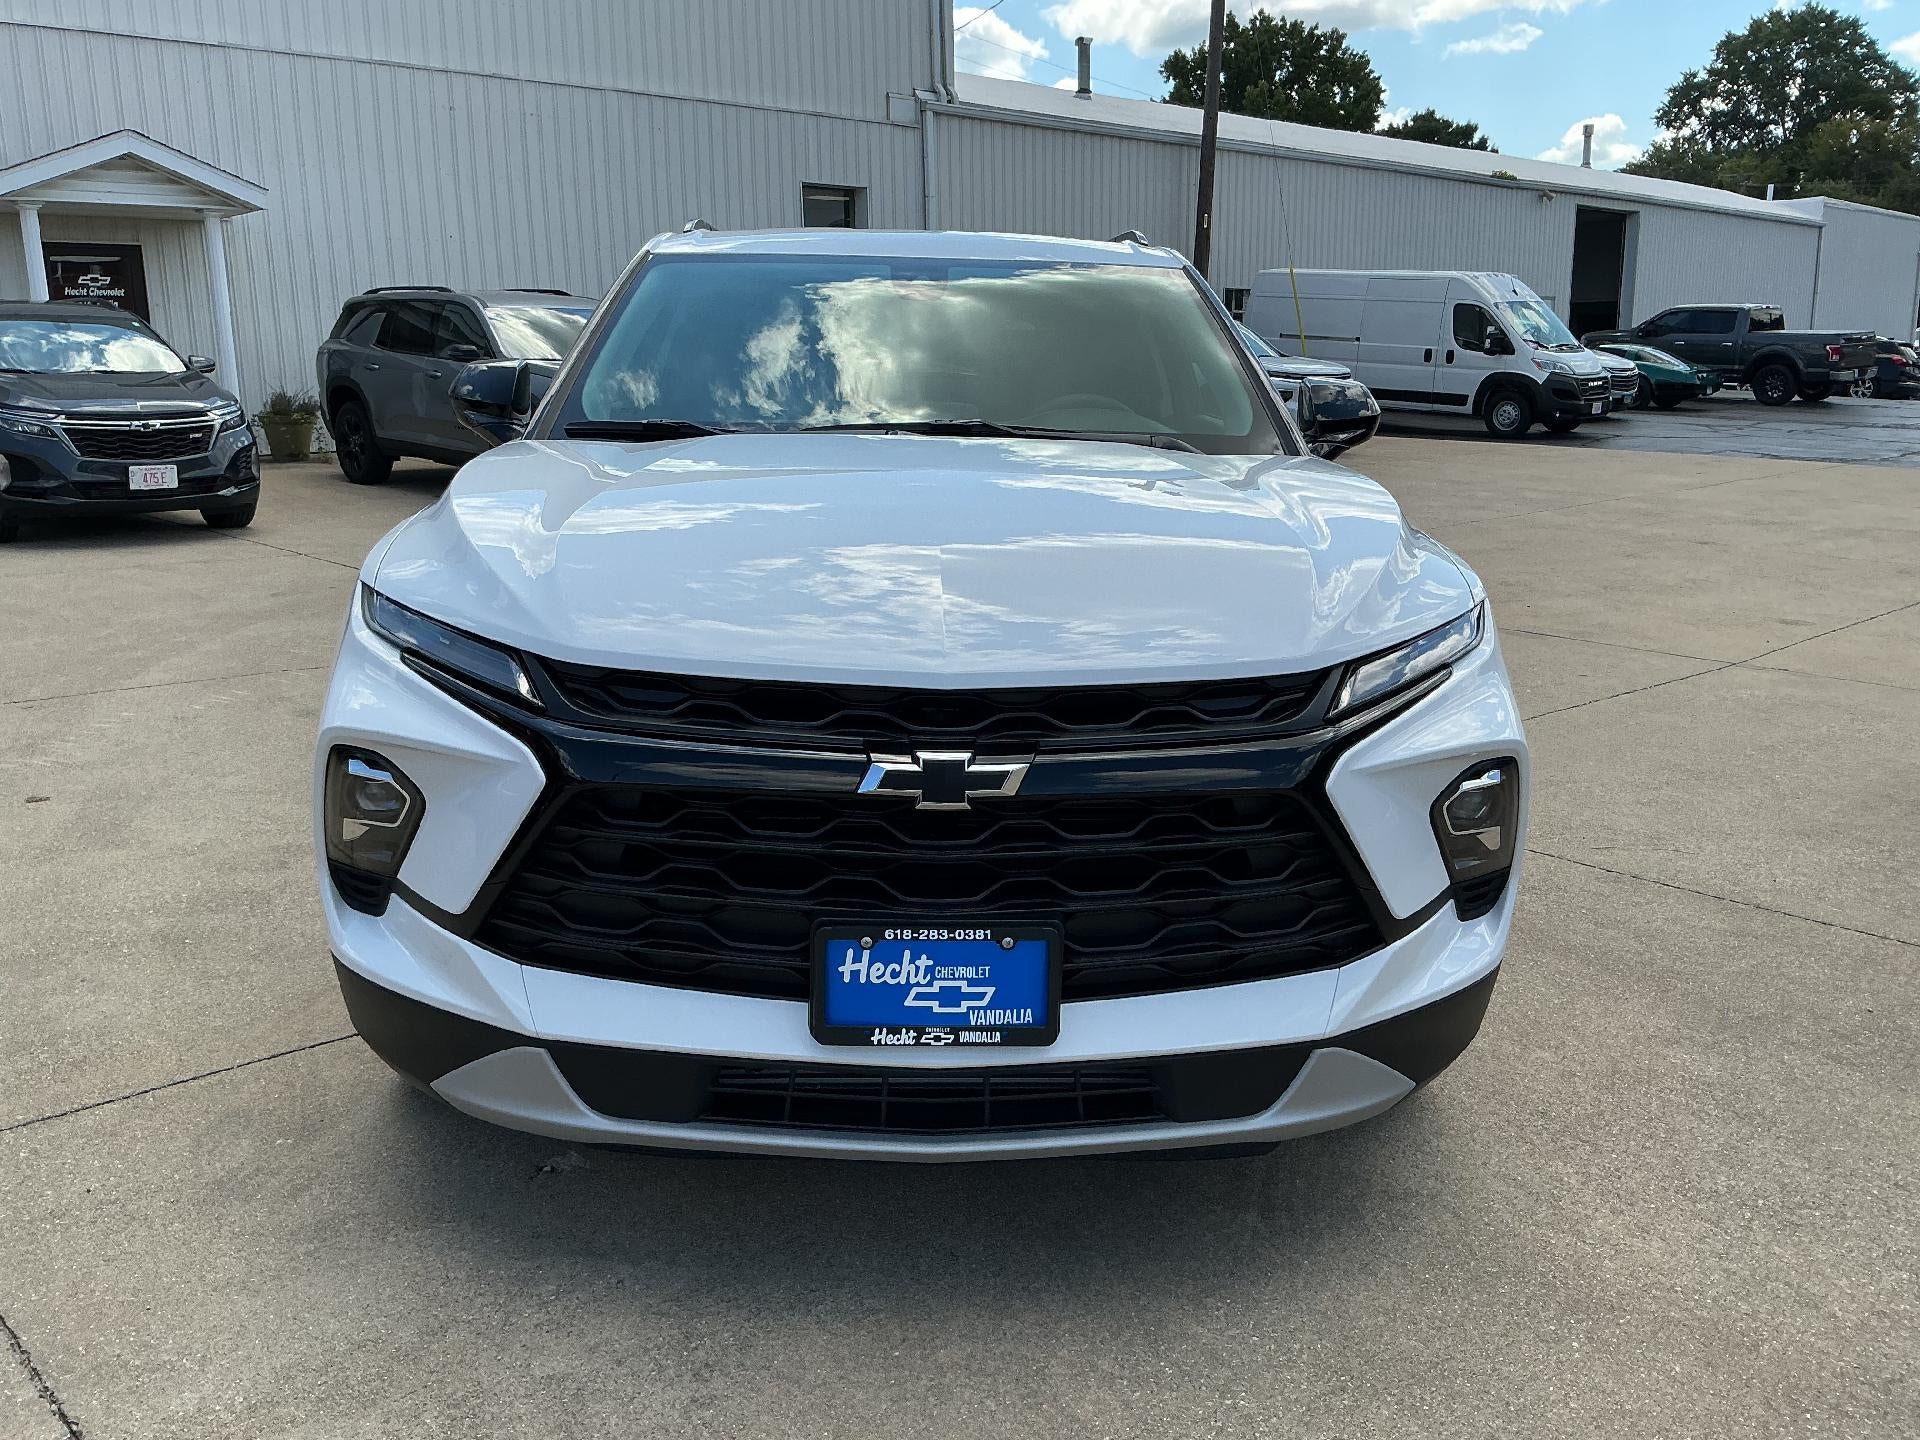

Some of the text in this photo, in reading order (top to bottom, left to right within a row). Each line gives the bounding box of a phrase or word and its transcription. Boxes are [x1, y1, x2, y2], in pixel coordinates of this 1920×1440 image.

[64, 286, 125, 297] Hecht Chevrolet
[884, 929, 991, 940] 618-283-0381
[838, 948, 990, 984] Hecht CHEVROLET
[969, 1008, 1033, 1025] VANDALIA
[871, 1027, 917, 1045] Hecht
[959, 1030, 1001, 1043] VANDALIA
